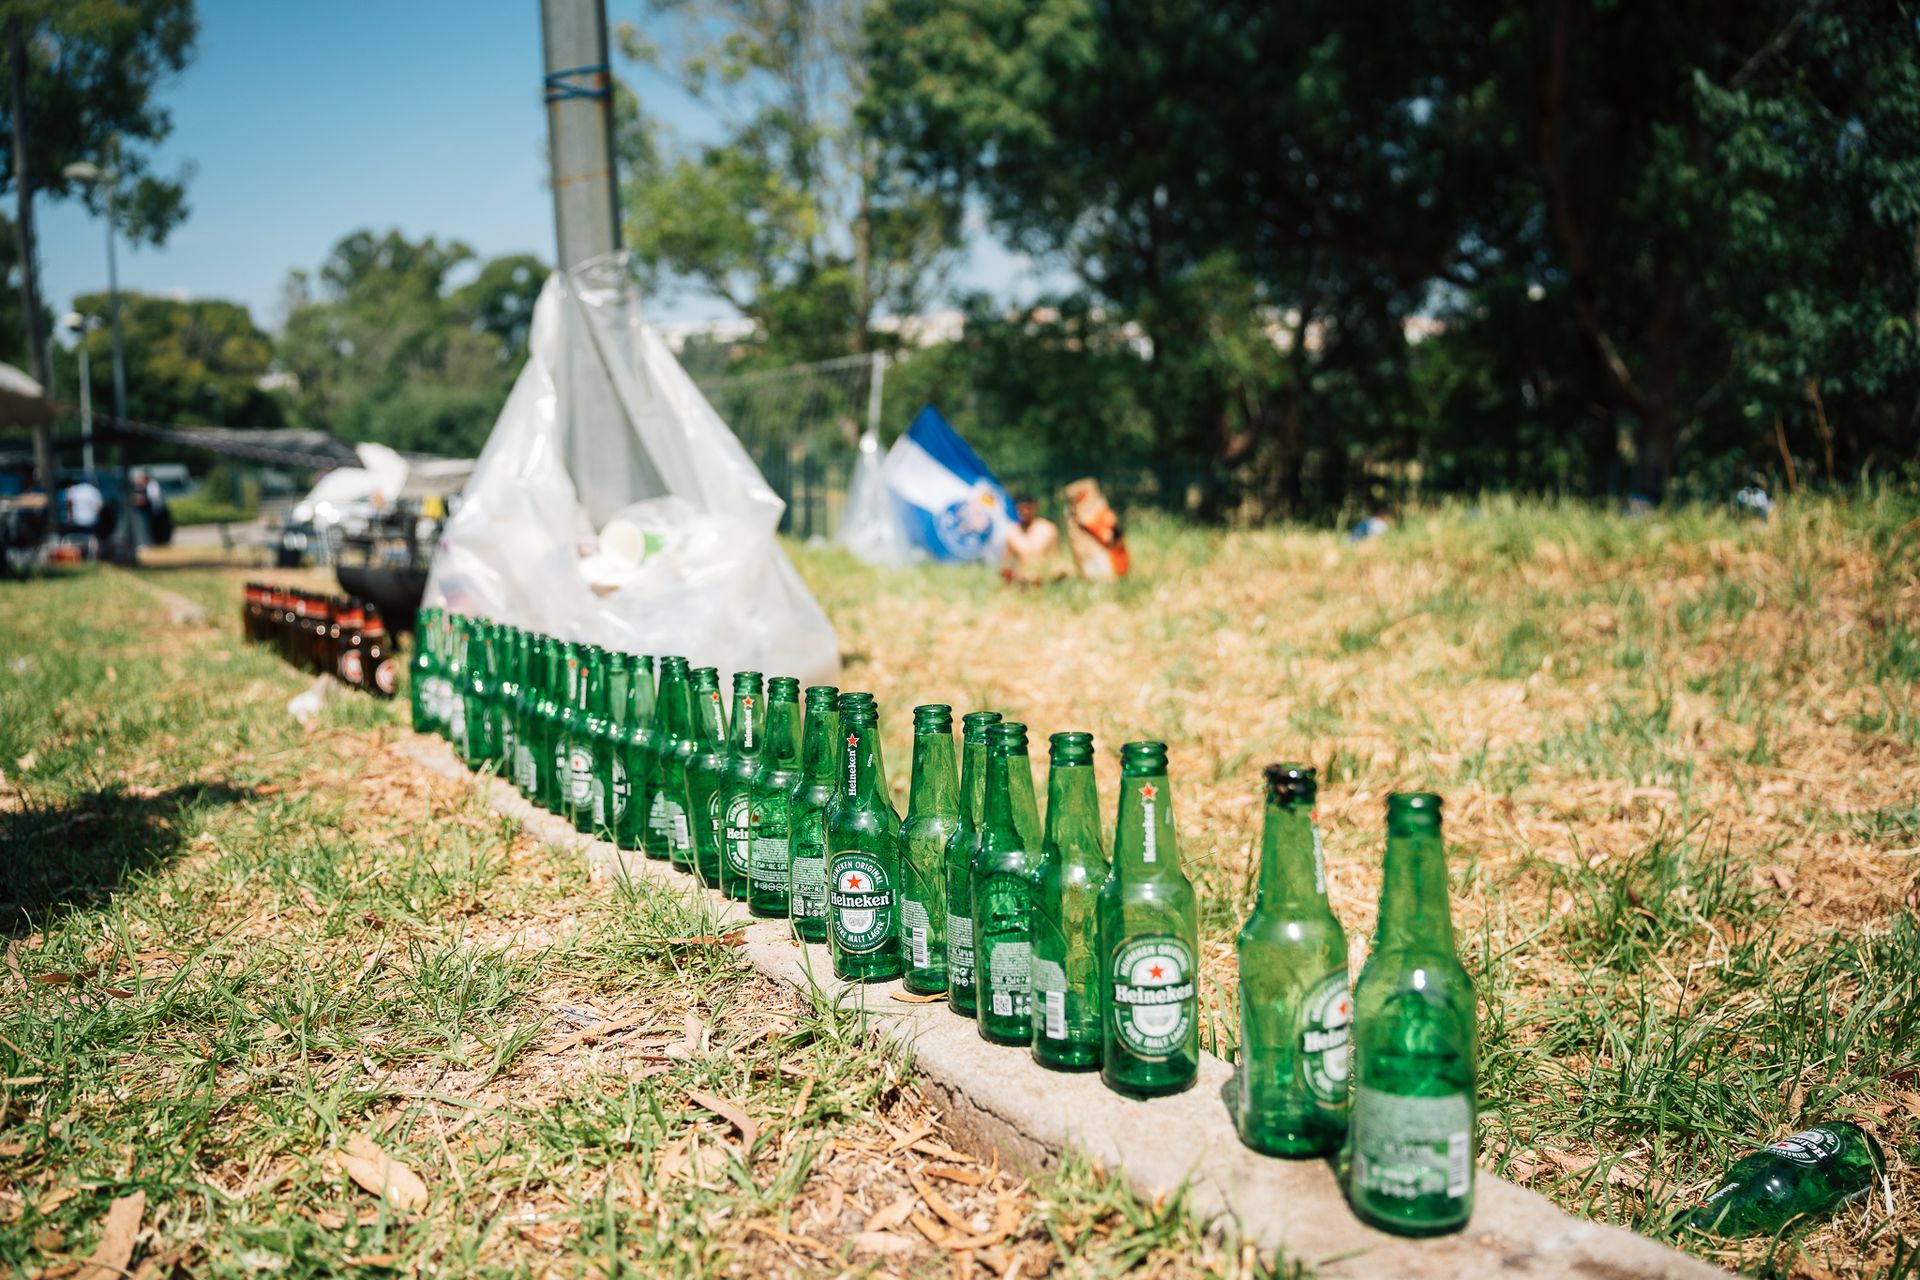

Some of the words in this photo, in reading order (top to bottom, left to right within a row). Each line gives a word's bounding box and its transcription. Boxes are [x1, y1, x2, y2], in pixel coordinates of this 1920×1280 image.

[848, 749, 857, 796] Heineken
[726, 828, 749, 840] Hein
[832, 861, 853, 884] HEINEKEN
[855, 861, 884, 884] ORIGINAL
[830, 890, 890, 908] Heineken
[835, 920, 846, 939] PURE
[867, 921, 885, 940] LAGER
[1115, 978, 1194, 1005] Heineken
